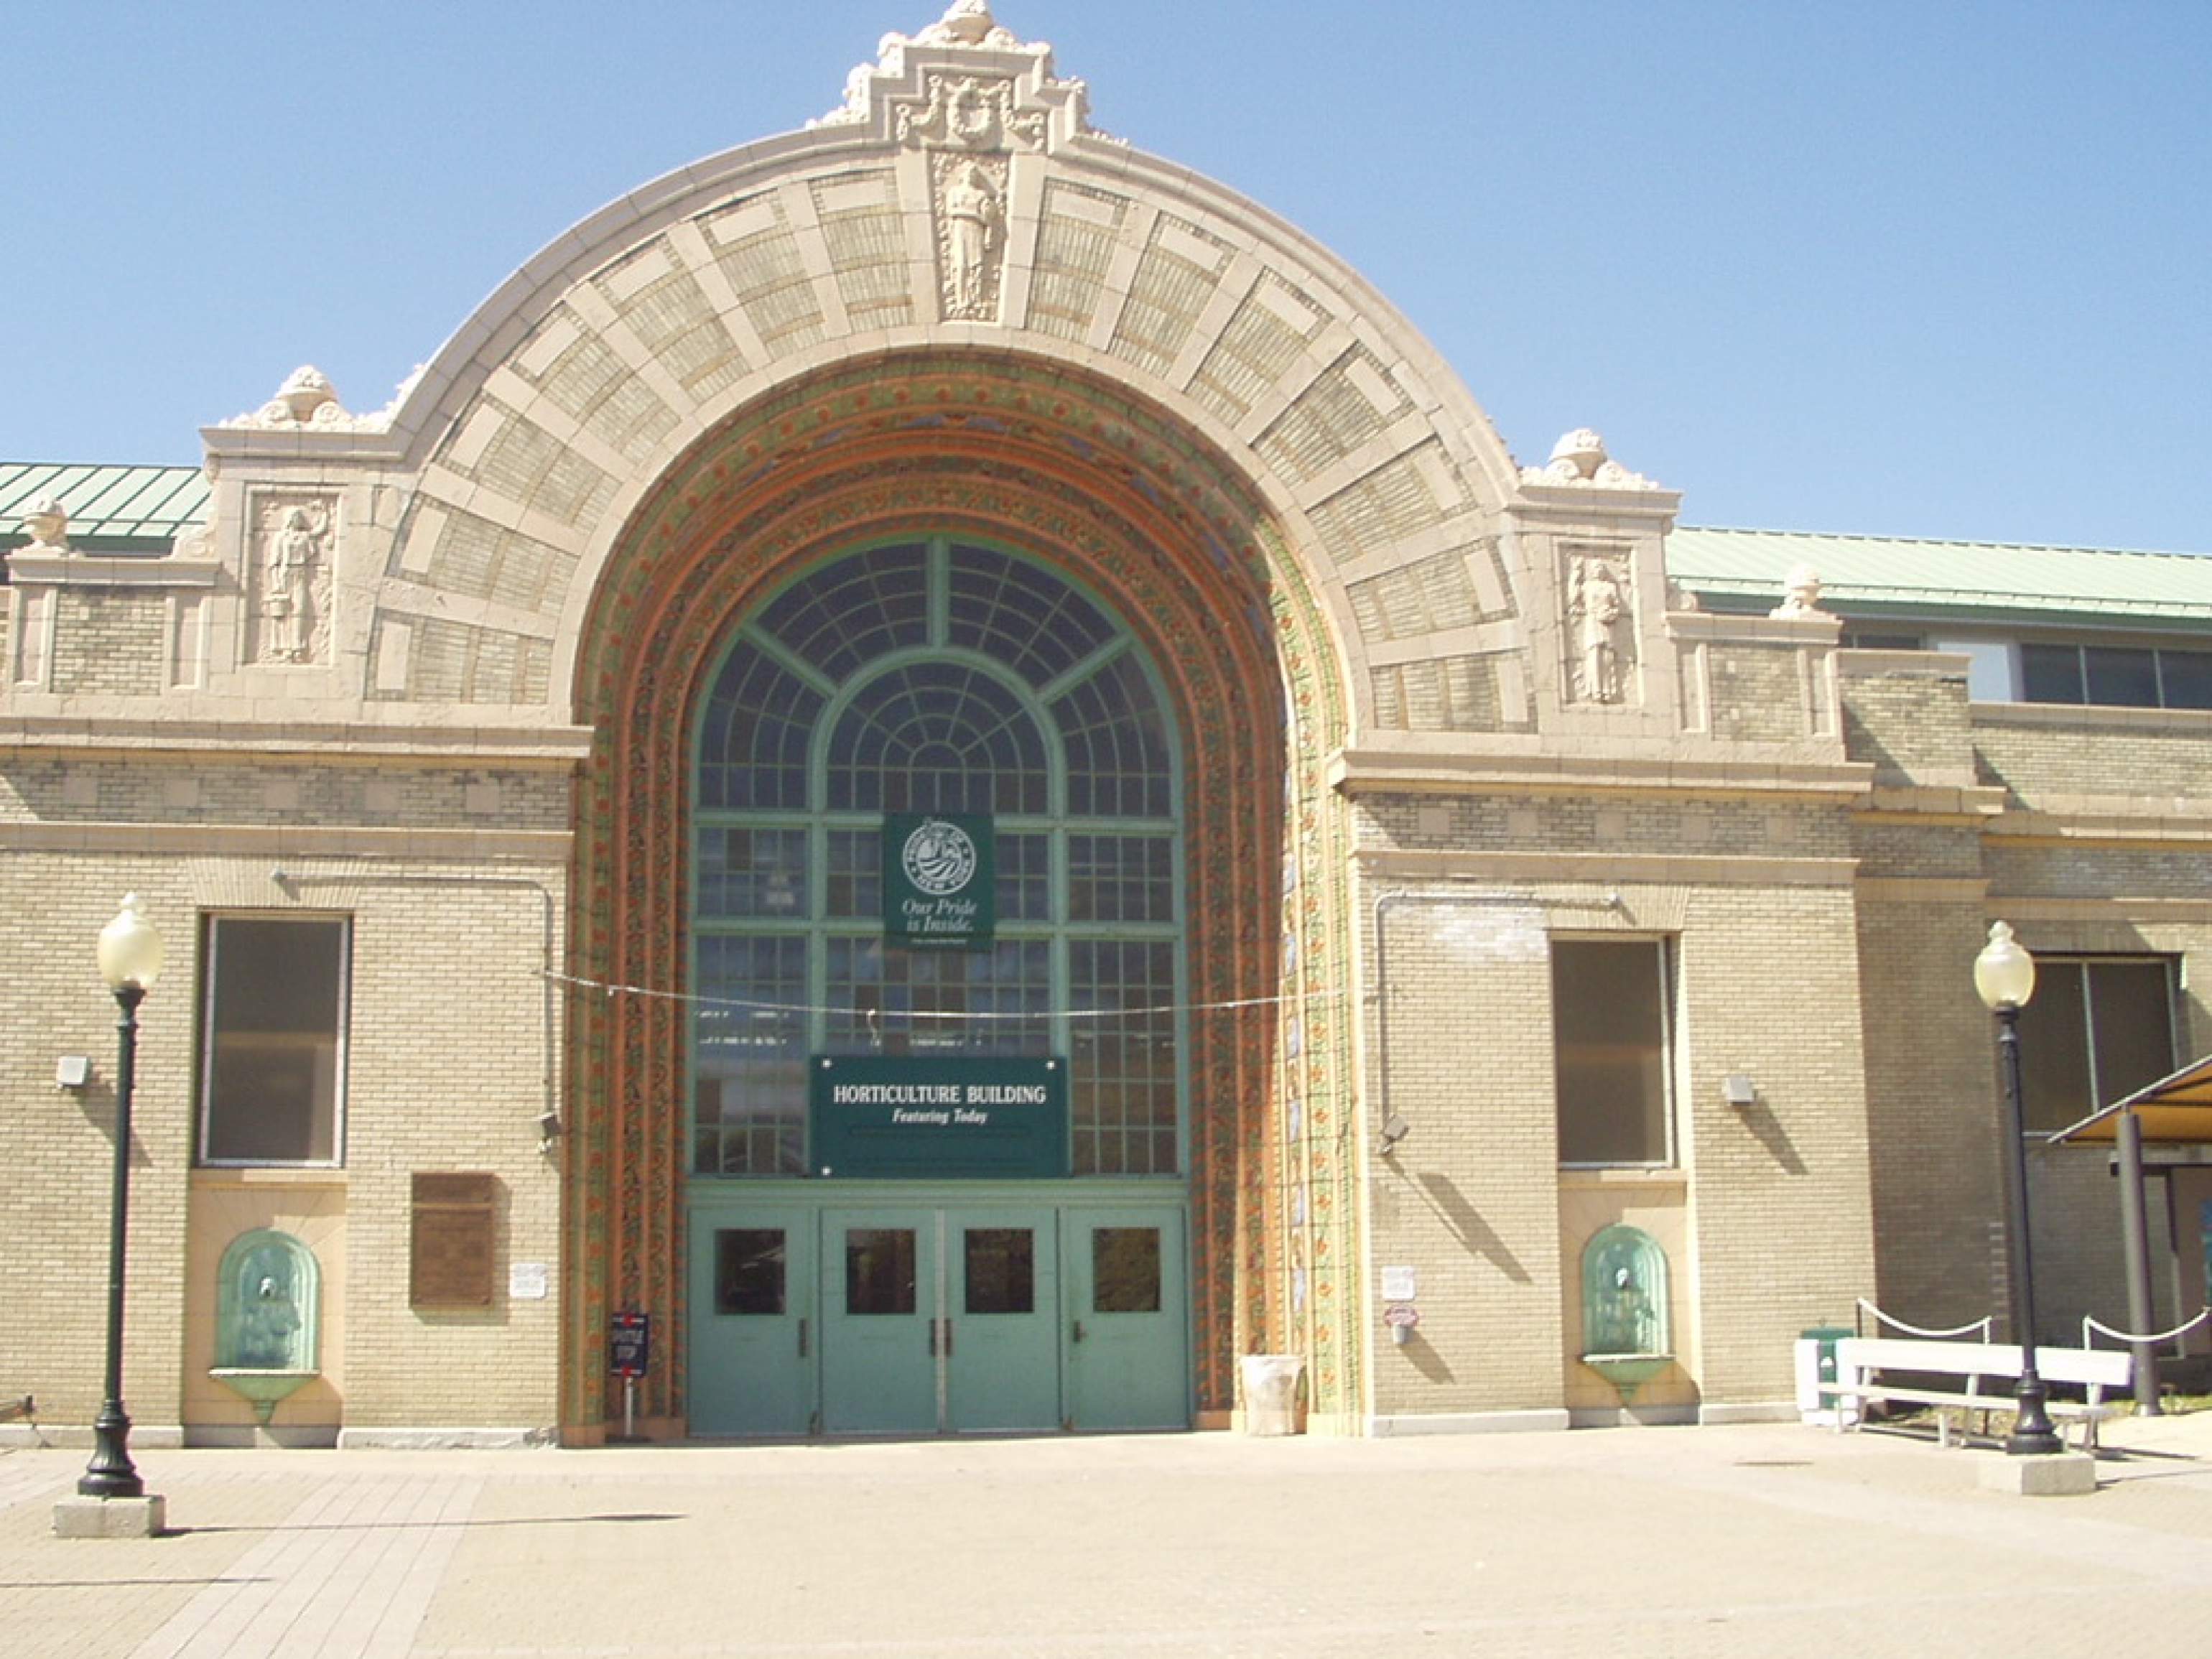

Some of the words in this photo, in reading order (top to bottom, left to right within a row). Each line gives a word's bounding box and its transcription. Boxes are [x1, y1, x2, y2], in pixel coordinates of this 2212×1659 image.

[936, 898, 977, 916] Pride
[833, 1084, 961, 1104] HORTICULTURE
[967, 1085, 1046, 1104] BUILDING
[891, 1108, 949, 1125] Featuring
[954, 1108, 988, 1125] Today
